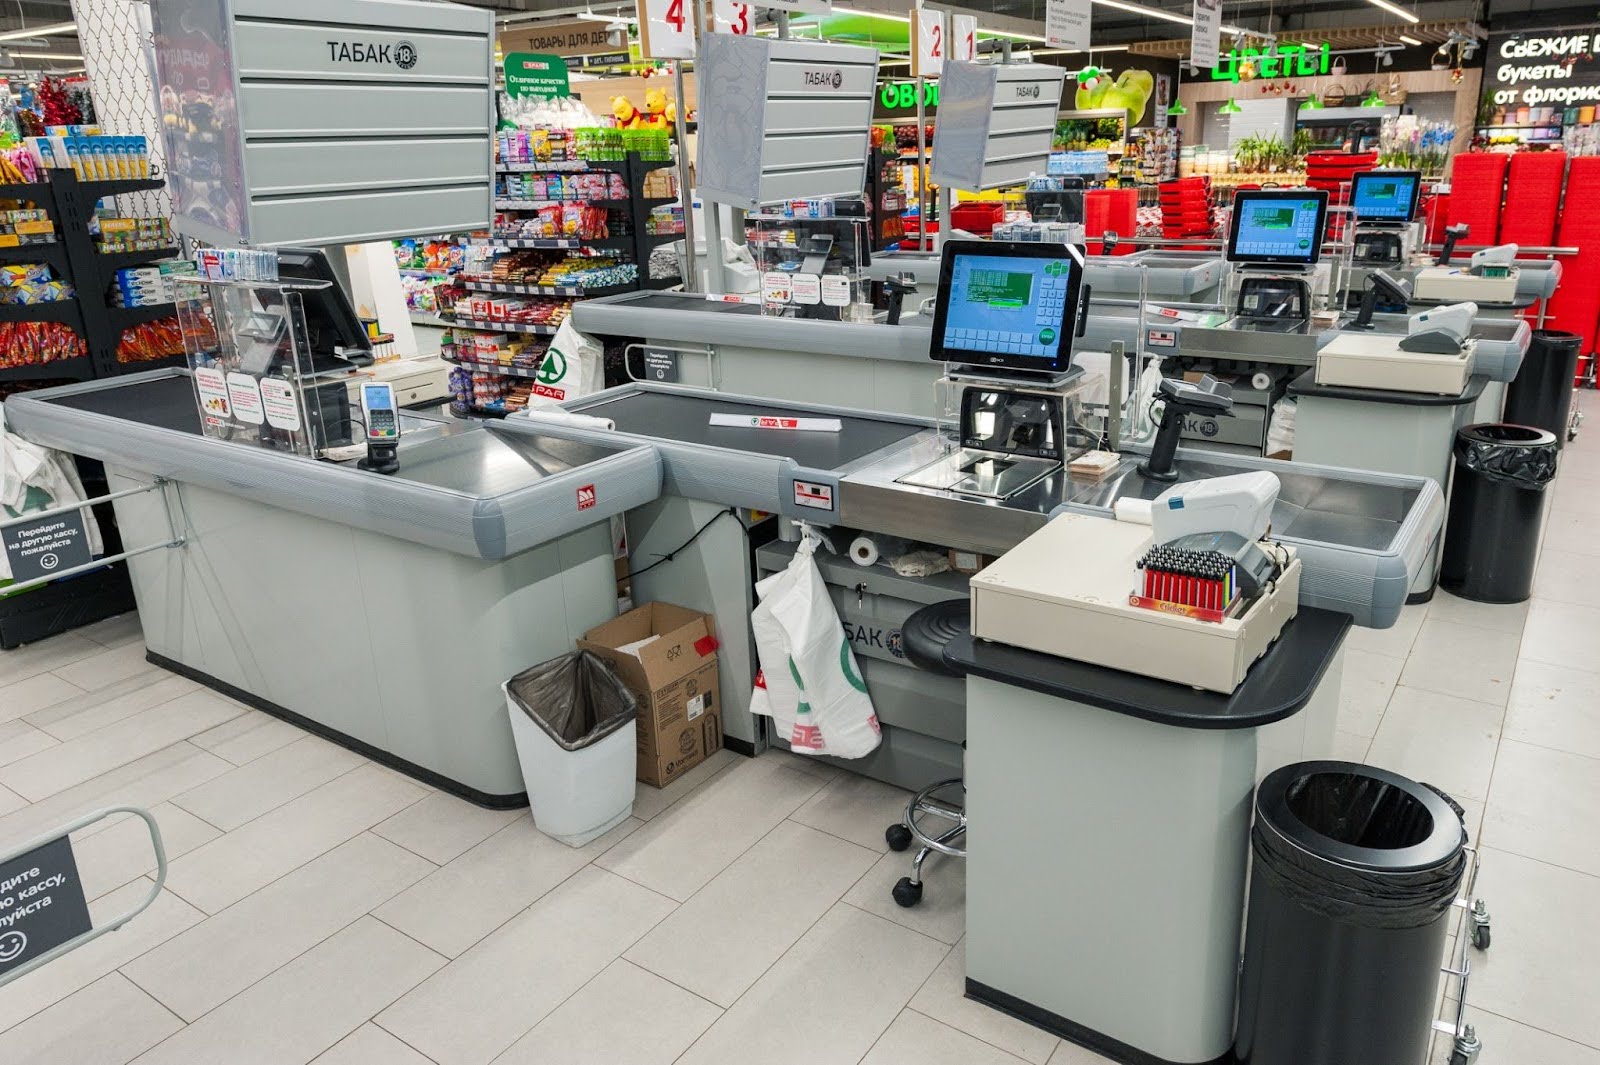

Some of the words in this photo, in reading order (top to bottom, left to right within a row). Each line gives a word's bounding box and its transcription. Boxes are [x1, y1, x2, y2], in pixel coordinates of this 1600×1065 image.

[666, 0, 685, 32] 4
[731, 3, 748, 35] 3
[326, 41, 391, 64] ТАБАК
[528, 33, 565, 50] ТОВАРЫ
[568, 33, 588, 48] ДЛЯ
[931, 25, 942, 57] 2
[966, 31, 974, 60] 1
[805, 72, 831, 86] ТАБАК
[1497, 64, 1573, 85] букеты
[881, 82, 939, 109] ОВО
[1494, 89, 1519, 104] от
[18, 522, 65, 538] Перейдите
[22, 535, 53, 548] другую
[54, 528, 78, 539] кассу,
[21, 539, 71, 556] пожалуйста
[0, 867, 41, 894] дите
[18, 872, 66, 901] кассу,
